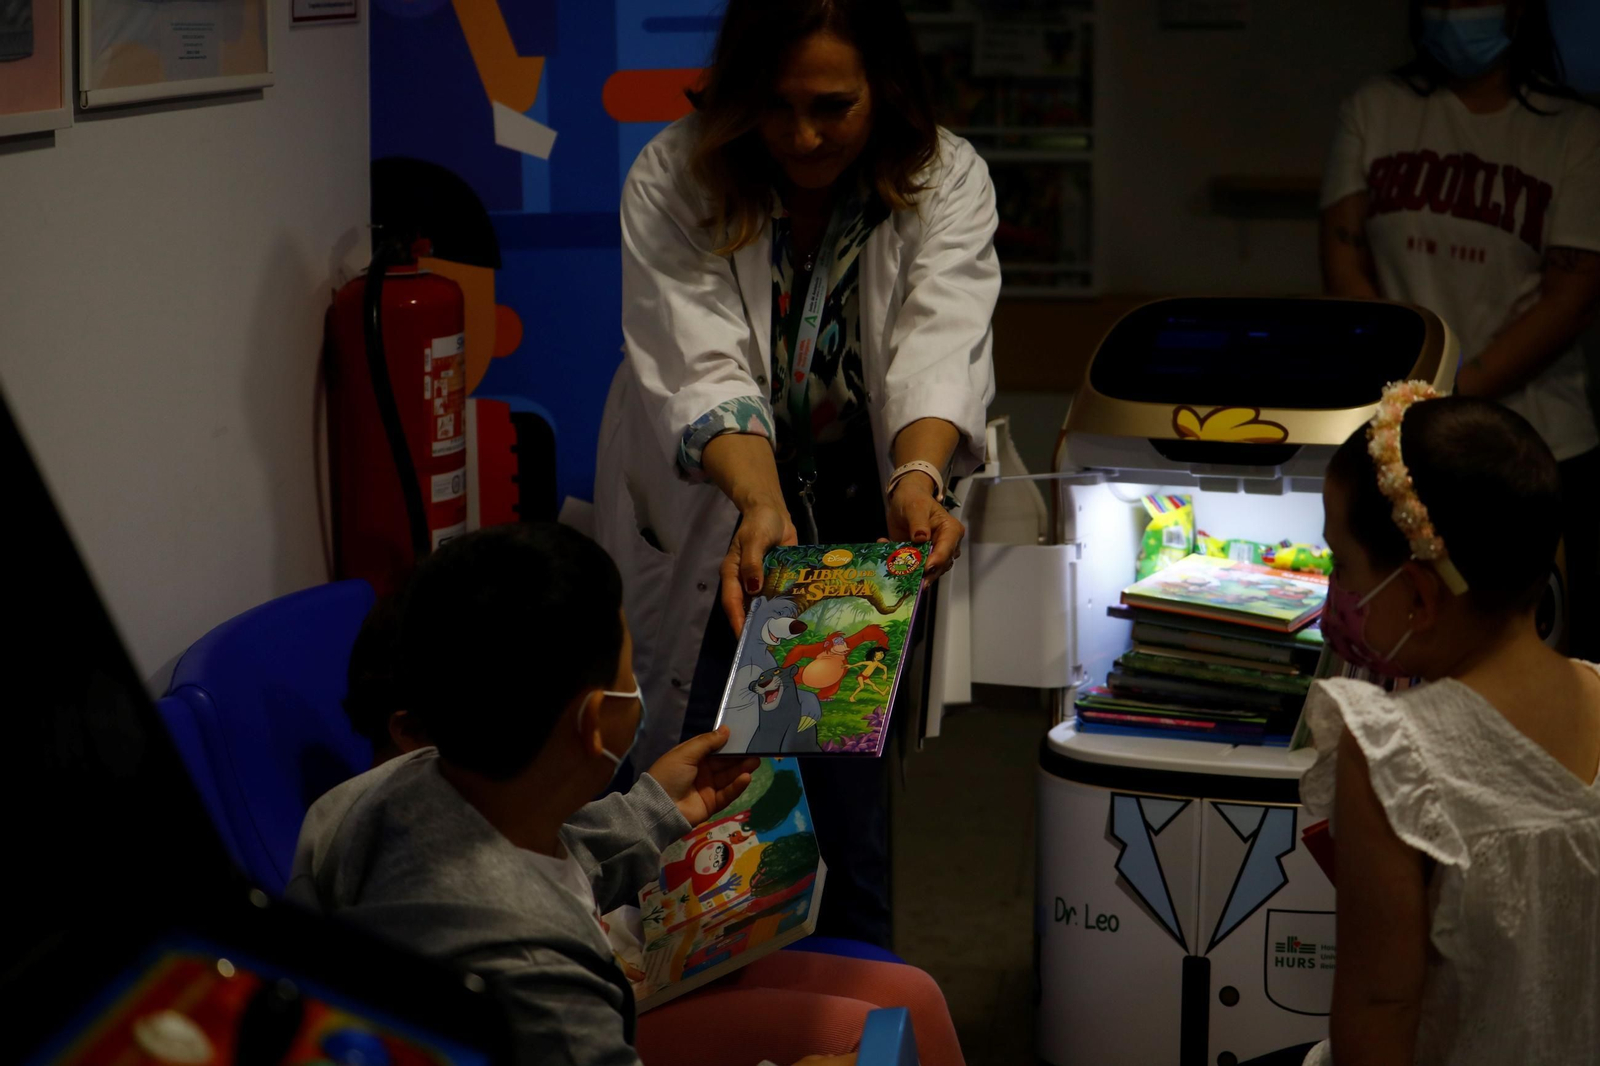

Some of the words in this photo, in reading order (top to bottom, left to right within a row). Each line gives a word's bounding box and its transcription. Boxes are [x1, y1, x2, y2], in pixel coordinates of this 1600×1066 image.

[826, 553, 851, 565] Disney
[795, 567, 858, 584] LIBRO
[859, 570, 877, 578] DE
[792, 587, 806, 595] LA
[806, 580, 874, 601] SELVA
[1055, 896, 1079, 927] Dr.
[1085, 904, 1120, 932] Leo
[1275, 956, 1316, 969] HURS
